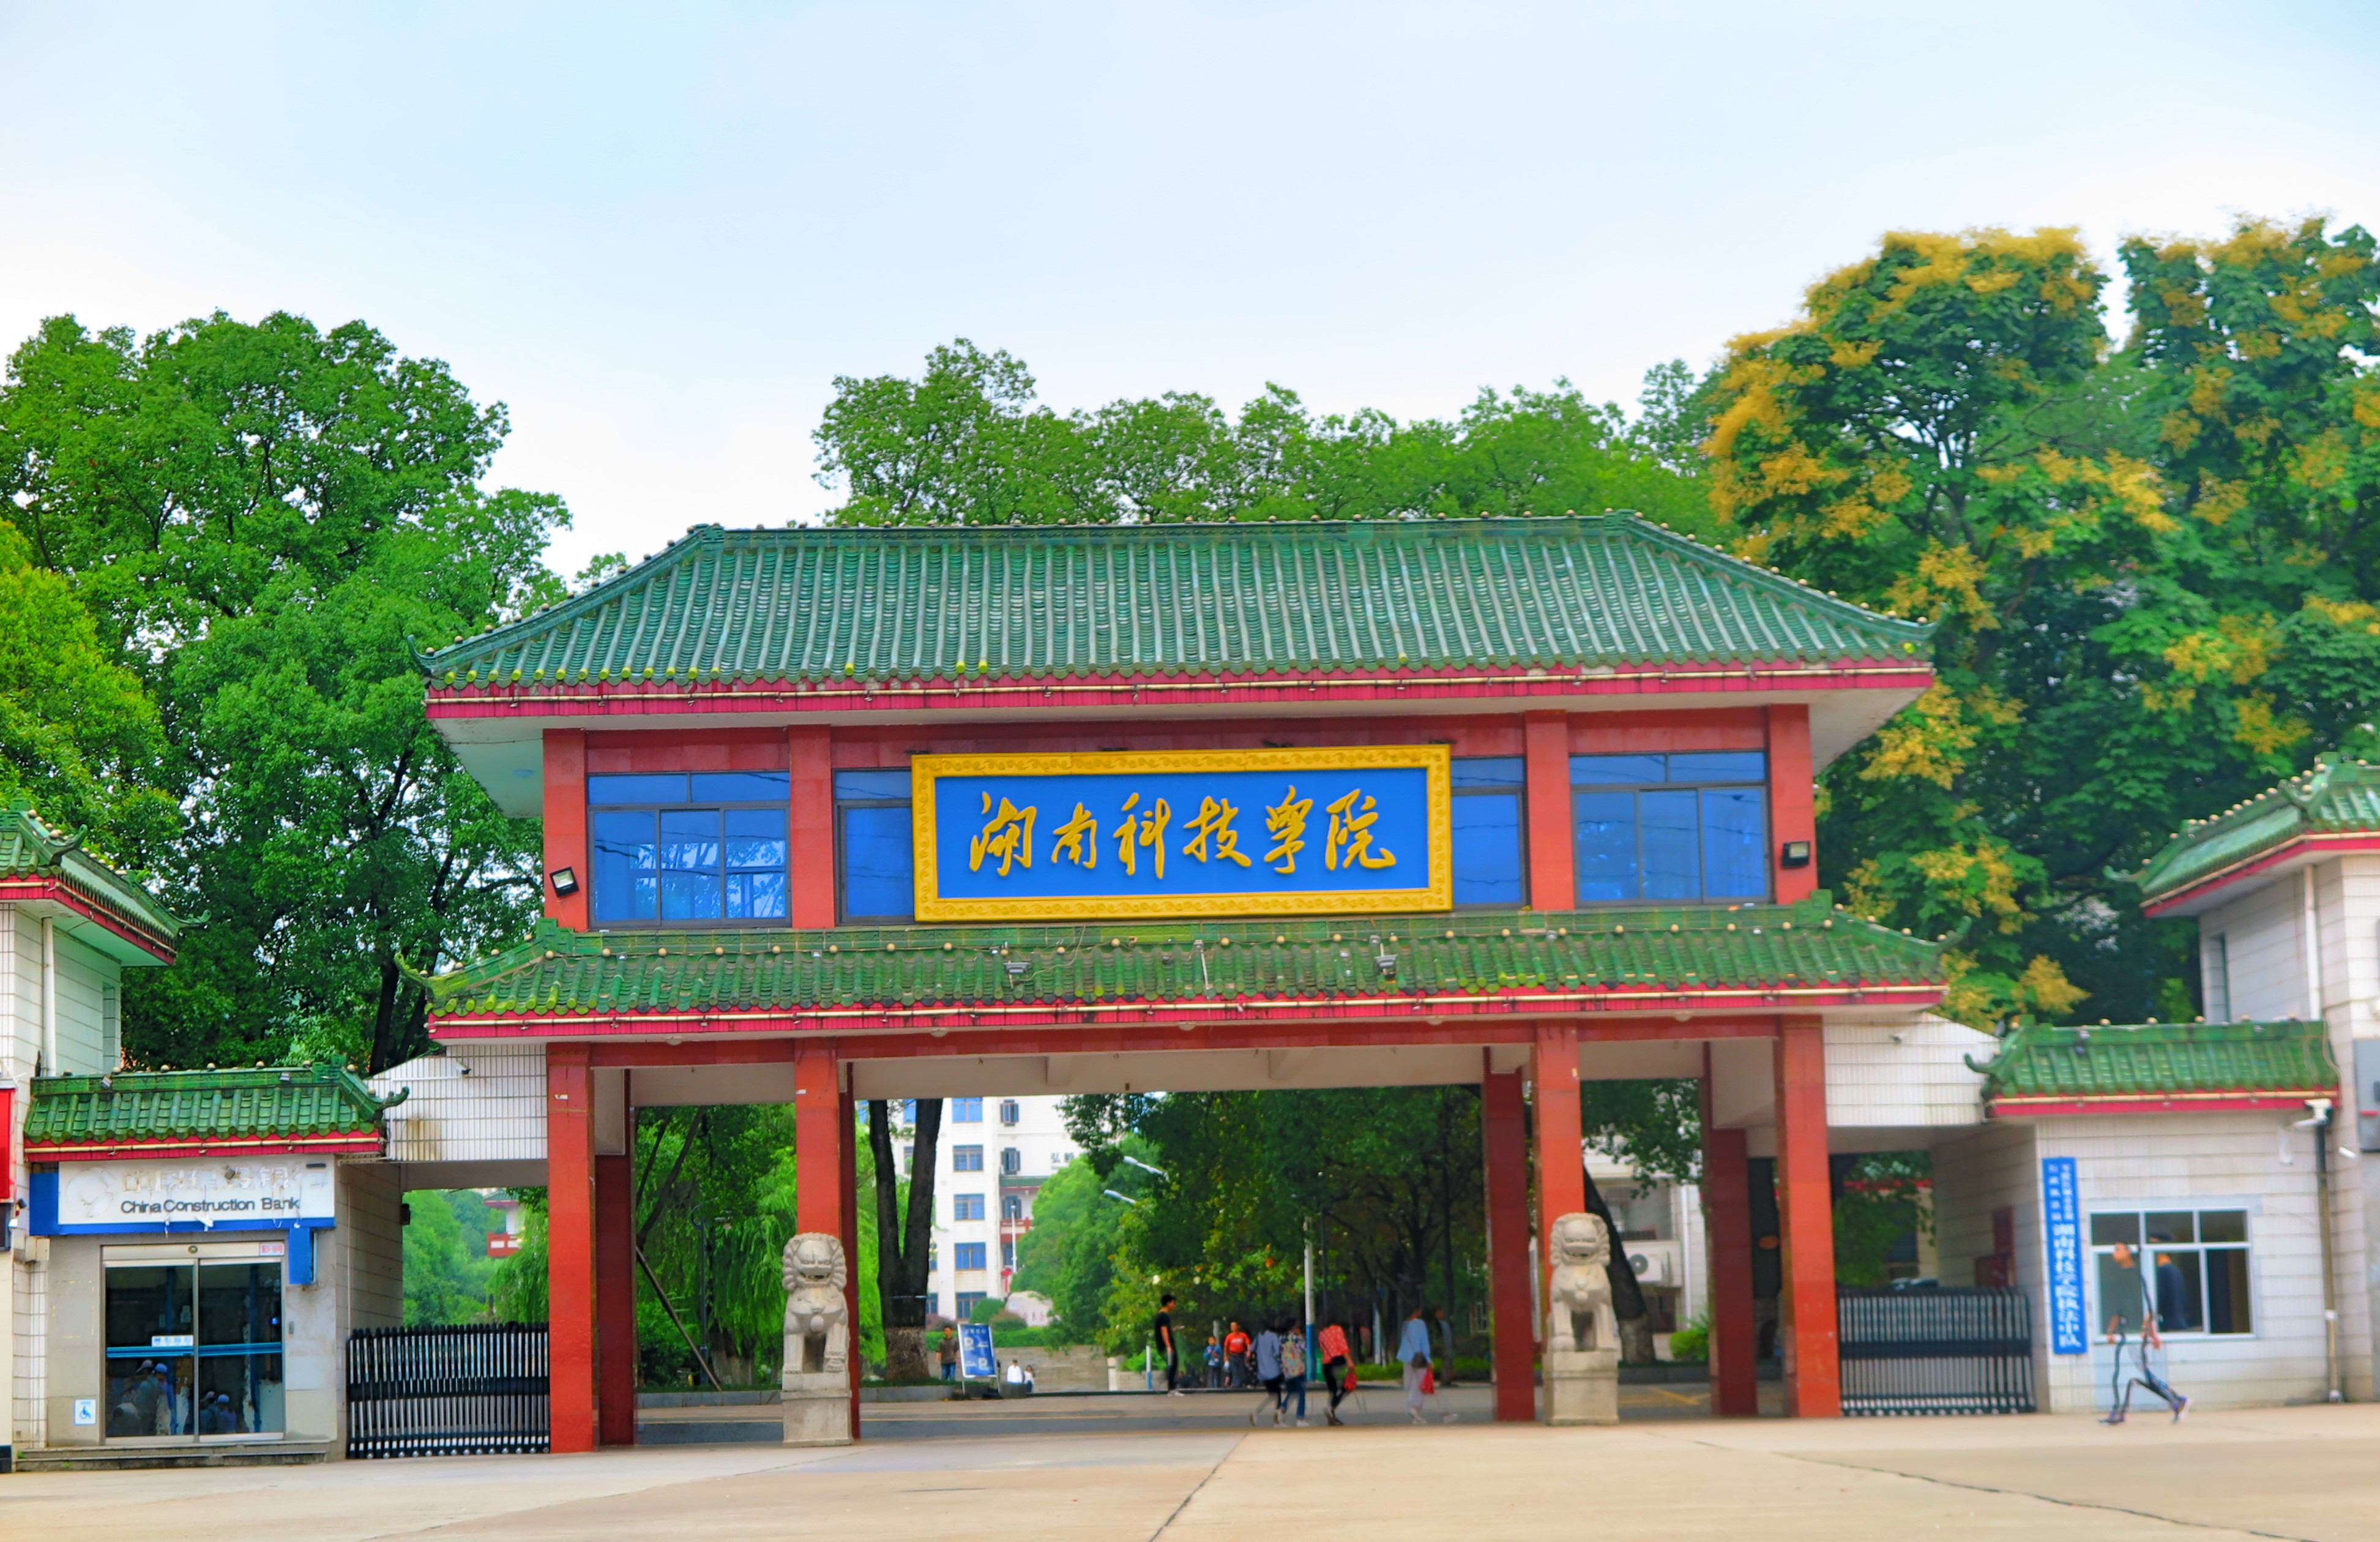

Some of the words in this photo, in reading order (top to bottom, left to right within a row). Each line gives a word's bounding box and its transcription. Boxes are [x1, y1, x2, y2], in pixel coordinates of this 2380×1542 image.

[122, 1198, 161, 1214] China
[165, 1197, 255, 1211] Construction
[262, 1196, 300, 1210] Bank
